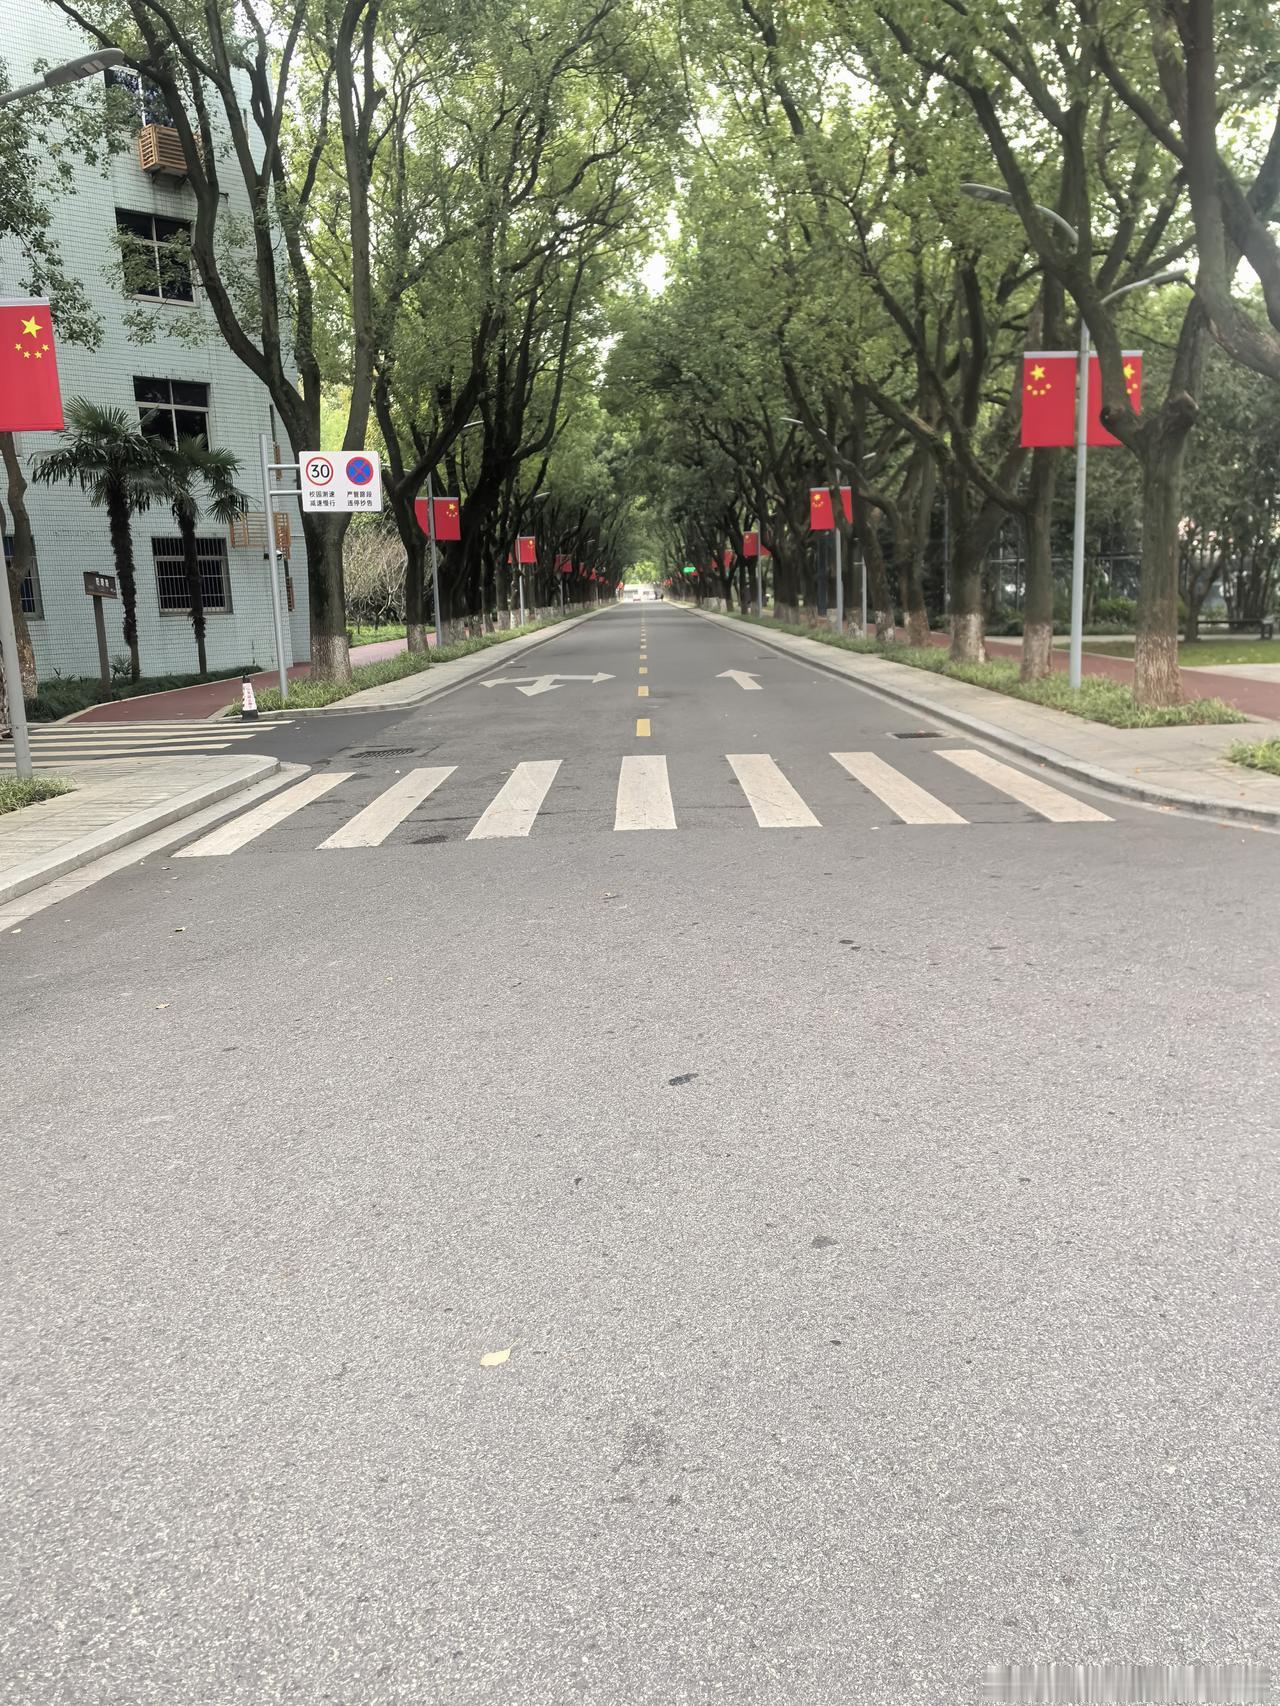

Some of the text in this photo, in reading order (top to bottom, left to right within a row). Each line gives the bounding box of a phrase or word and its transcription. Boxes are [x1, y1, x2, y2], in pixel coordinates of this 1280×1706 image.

[311, 464, 330, 478] 30
[310, 499, 336, 507] 减速慢行
[347, 499, 373, 507] 违停抄告
